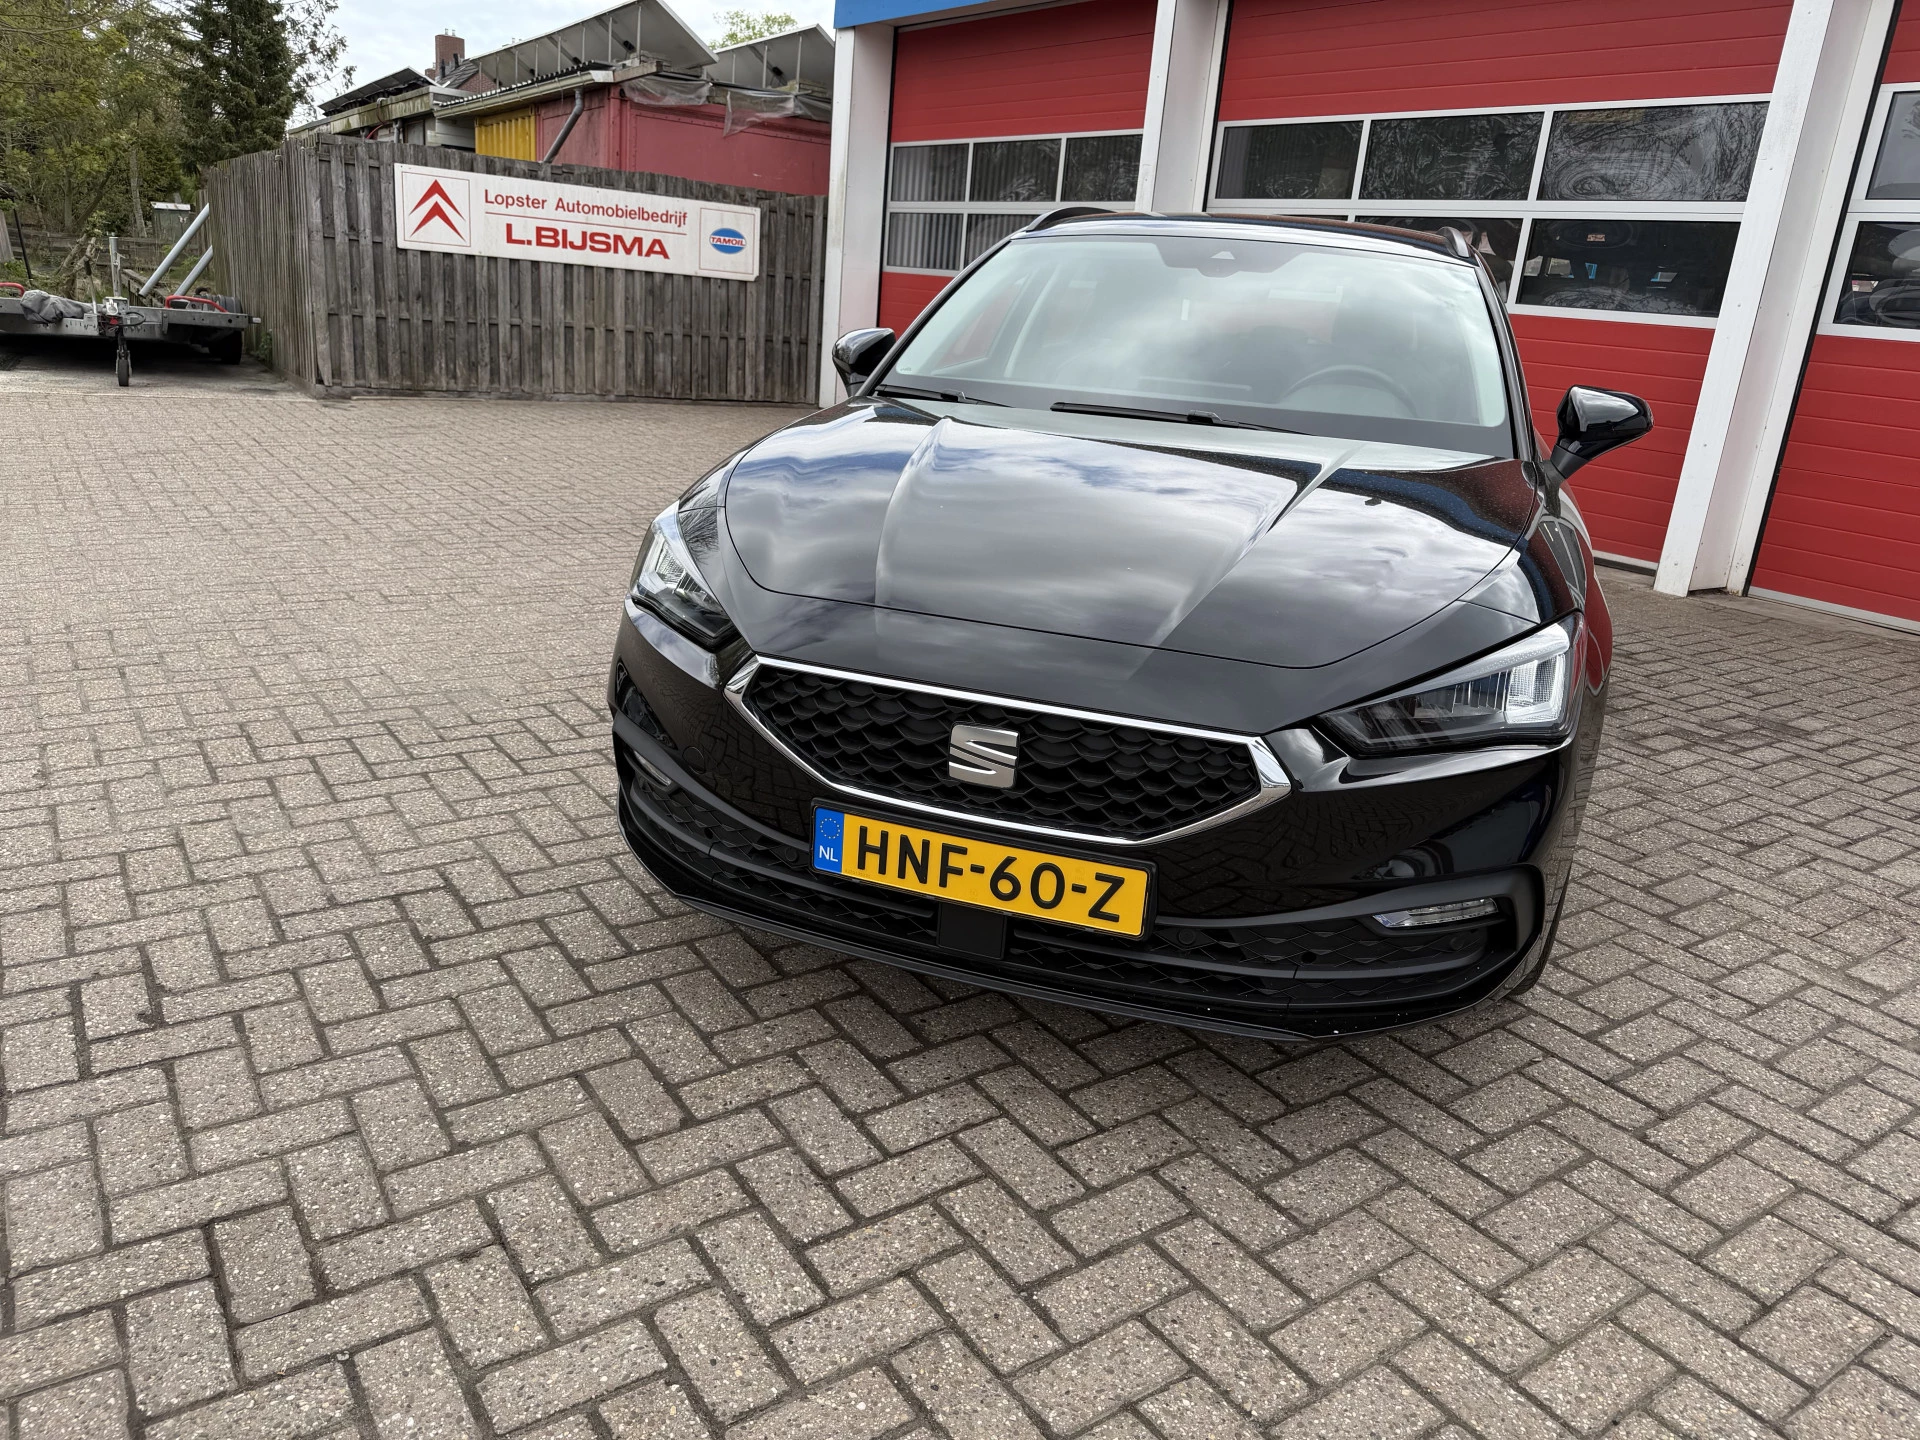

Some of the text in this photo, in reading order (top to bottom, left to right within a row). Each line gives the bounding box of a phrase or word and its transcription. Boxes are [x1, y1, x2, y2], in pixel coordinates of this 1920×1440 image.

[484, 189, 688, 227] Lopster Automobielbedrijf
[506, 223, 670, 260] L.BIJSMA
[711, 236, 745, 246] TAMOIL
[818, 845, 838, 862] NL
[857, 826, 1125, 923] HNF-60-Z
